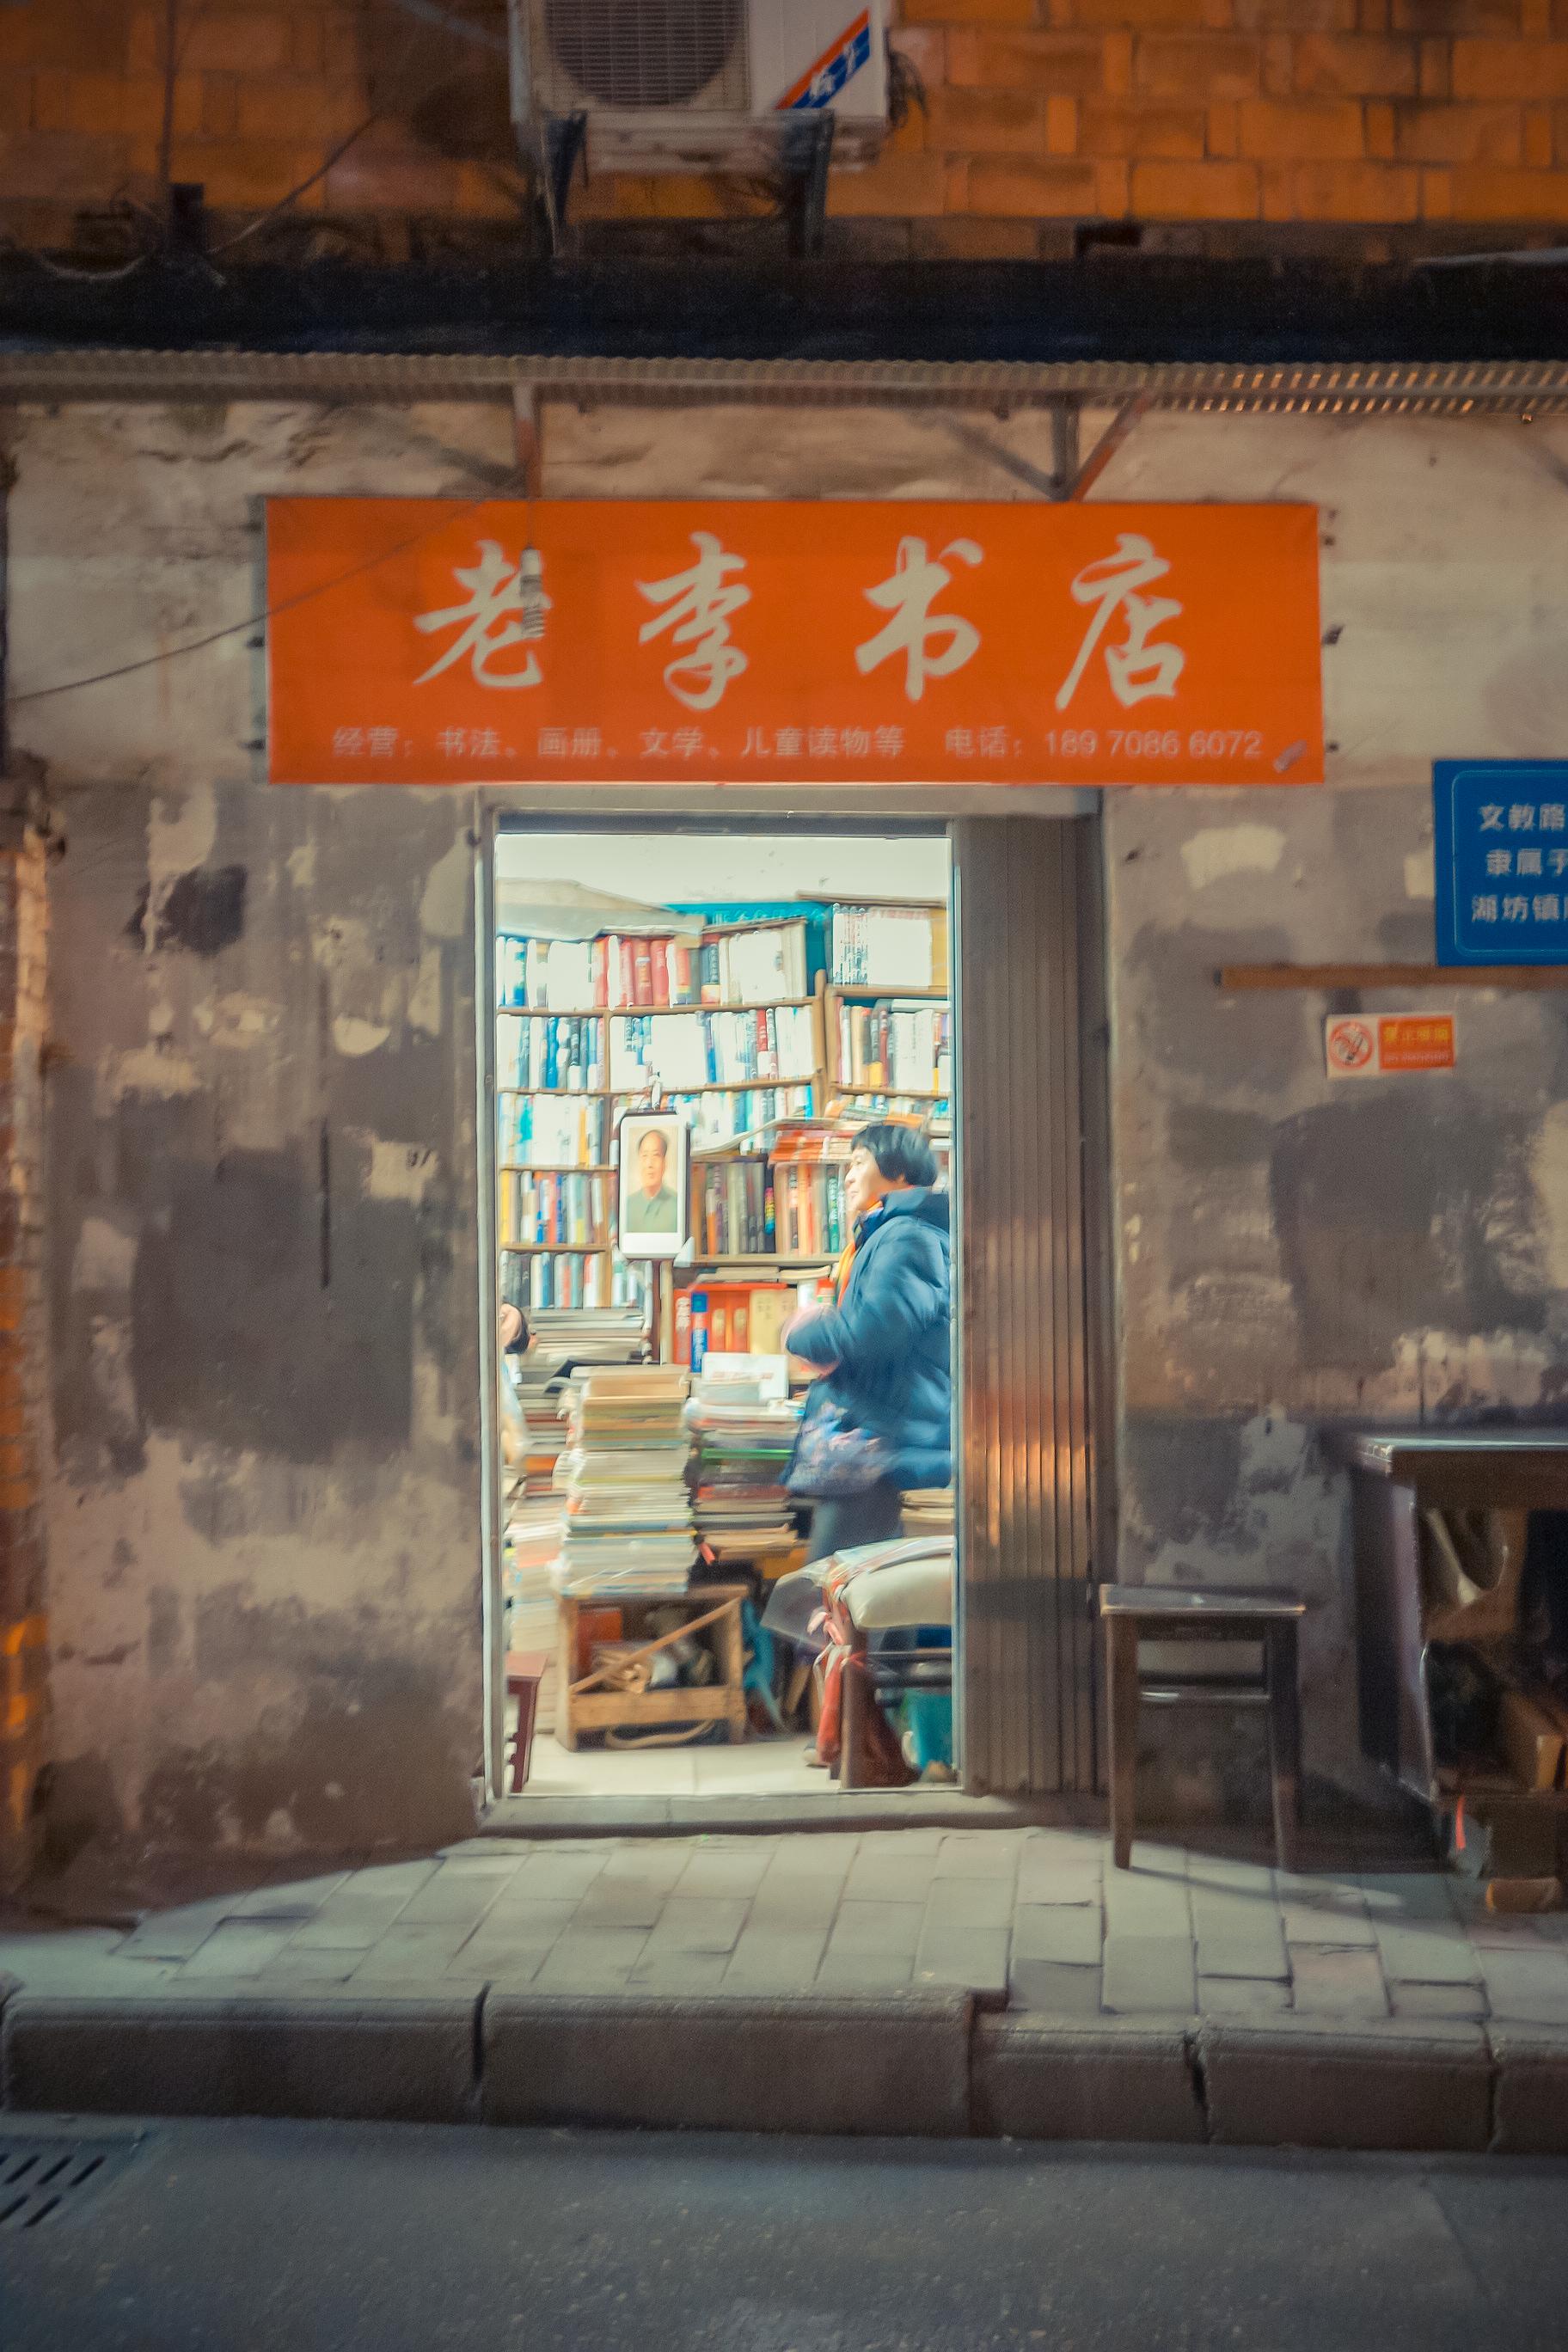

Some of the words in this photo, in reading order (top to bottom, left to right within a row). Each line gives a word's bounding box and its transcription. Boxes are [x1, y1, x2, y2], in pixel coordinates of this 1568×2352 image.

[413, 532, 1185, 710] 老李书店
[1045, 730, 1096, 757] 189
[1472, 894, 1568, 922] 湖坊镇
